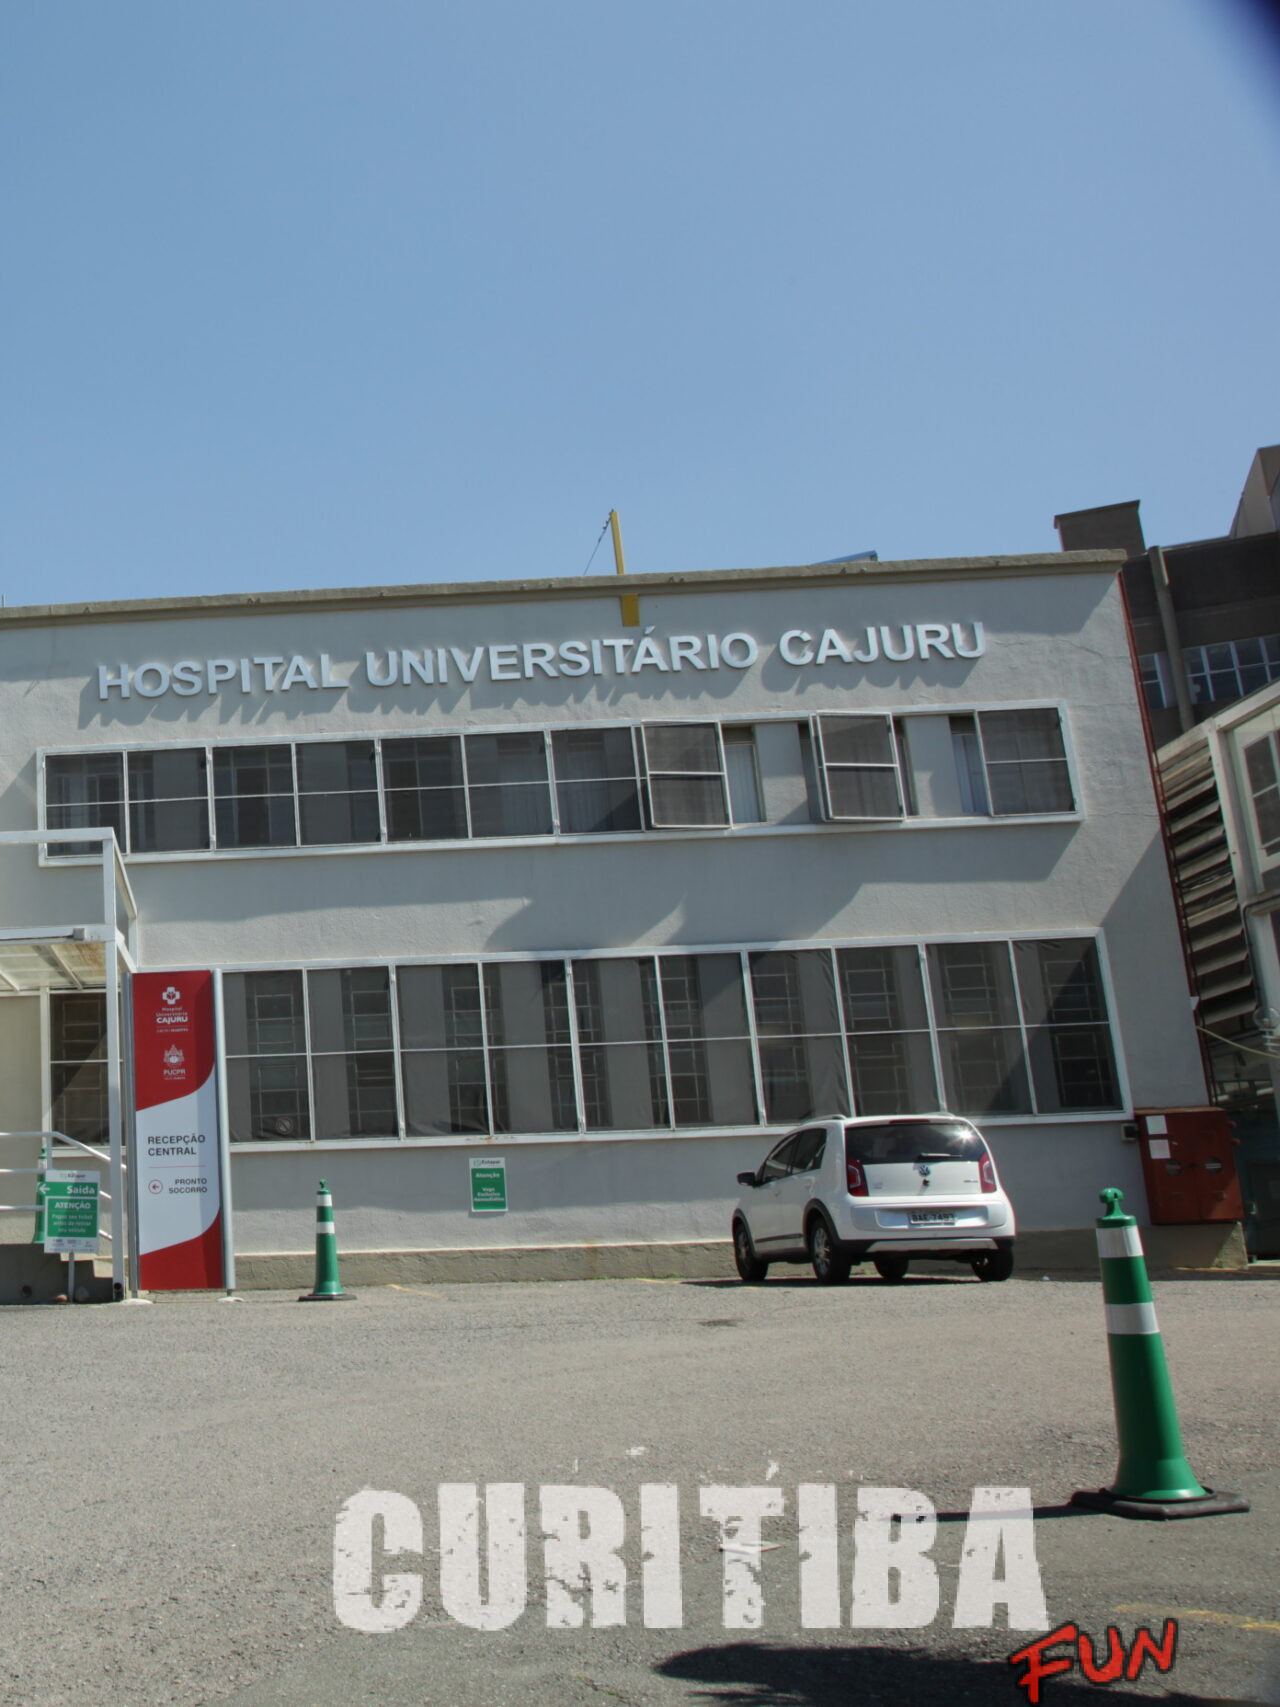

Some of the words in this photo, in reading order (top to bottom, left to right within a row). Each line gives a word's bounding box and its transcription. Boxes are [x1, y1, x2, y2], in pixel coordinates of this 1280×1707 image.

[98, 653, 349, 700] HOSPITAL
[365, 625, 758, 688] UNIVERSITÁRIO
[779, 621, 987, 666] CAJURU
[156, 1016, 189, 1024] CAJURU
[147, 1133, 206, 1145] RECEPÇÃO
[147, 1147, 197, 1157] CENTRAL
[174, 1177, 208, 1185] PRONTO
[66, 1185, 95, 1194] Saída
[168, 1185, 208, 1194] SOCORRO
[54, 1201, 91, 1210] ATENÇÃO
